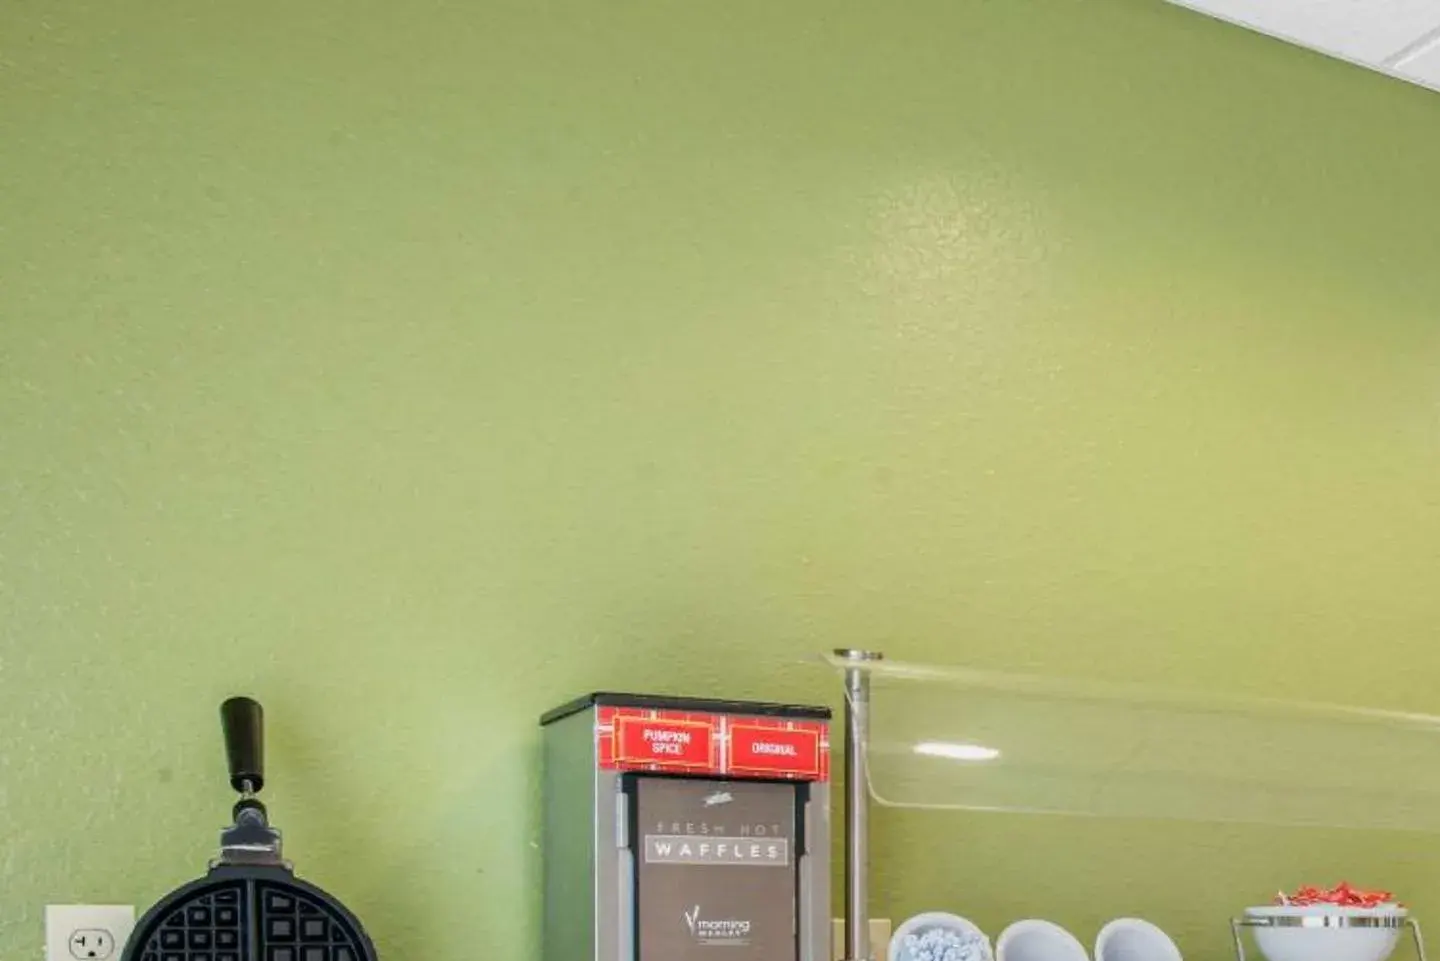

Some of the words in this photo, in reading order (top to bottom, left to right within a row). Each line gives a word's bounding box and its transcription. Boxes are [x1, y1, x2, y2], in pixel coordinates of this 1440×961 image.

[643, 729, 691, 744] PUMPKIN
[651, 743, 683, 755] SPICE
[752, 742, 797, 756] ORIGINAL
[656, 821, 725, 835] FRESH
[740, 823, 780, 837] HOT
[655, 841, 779, 859] WAFFLES
